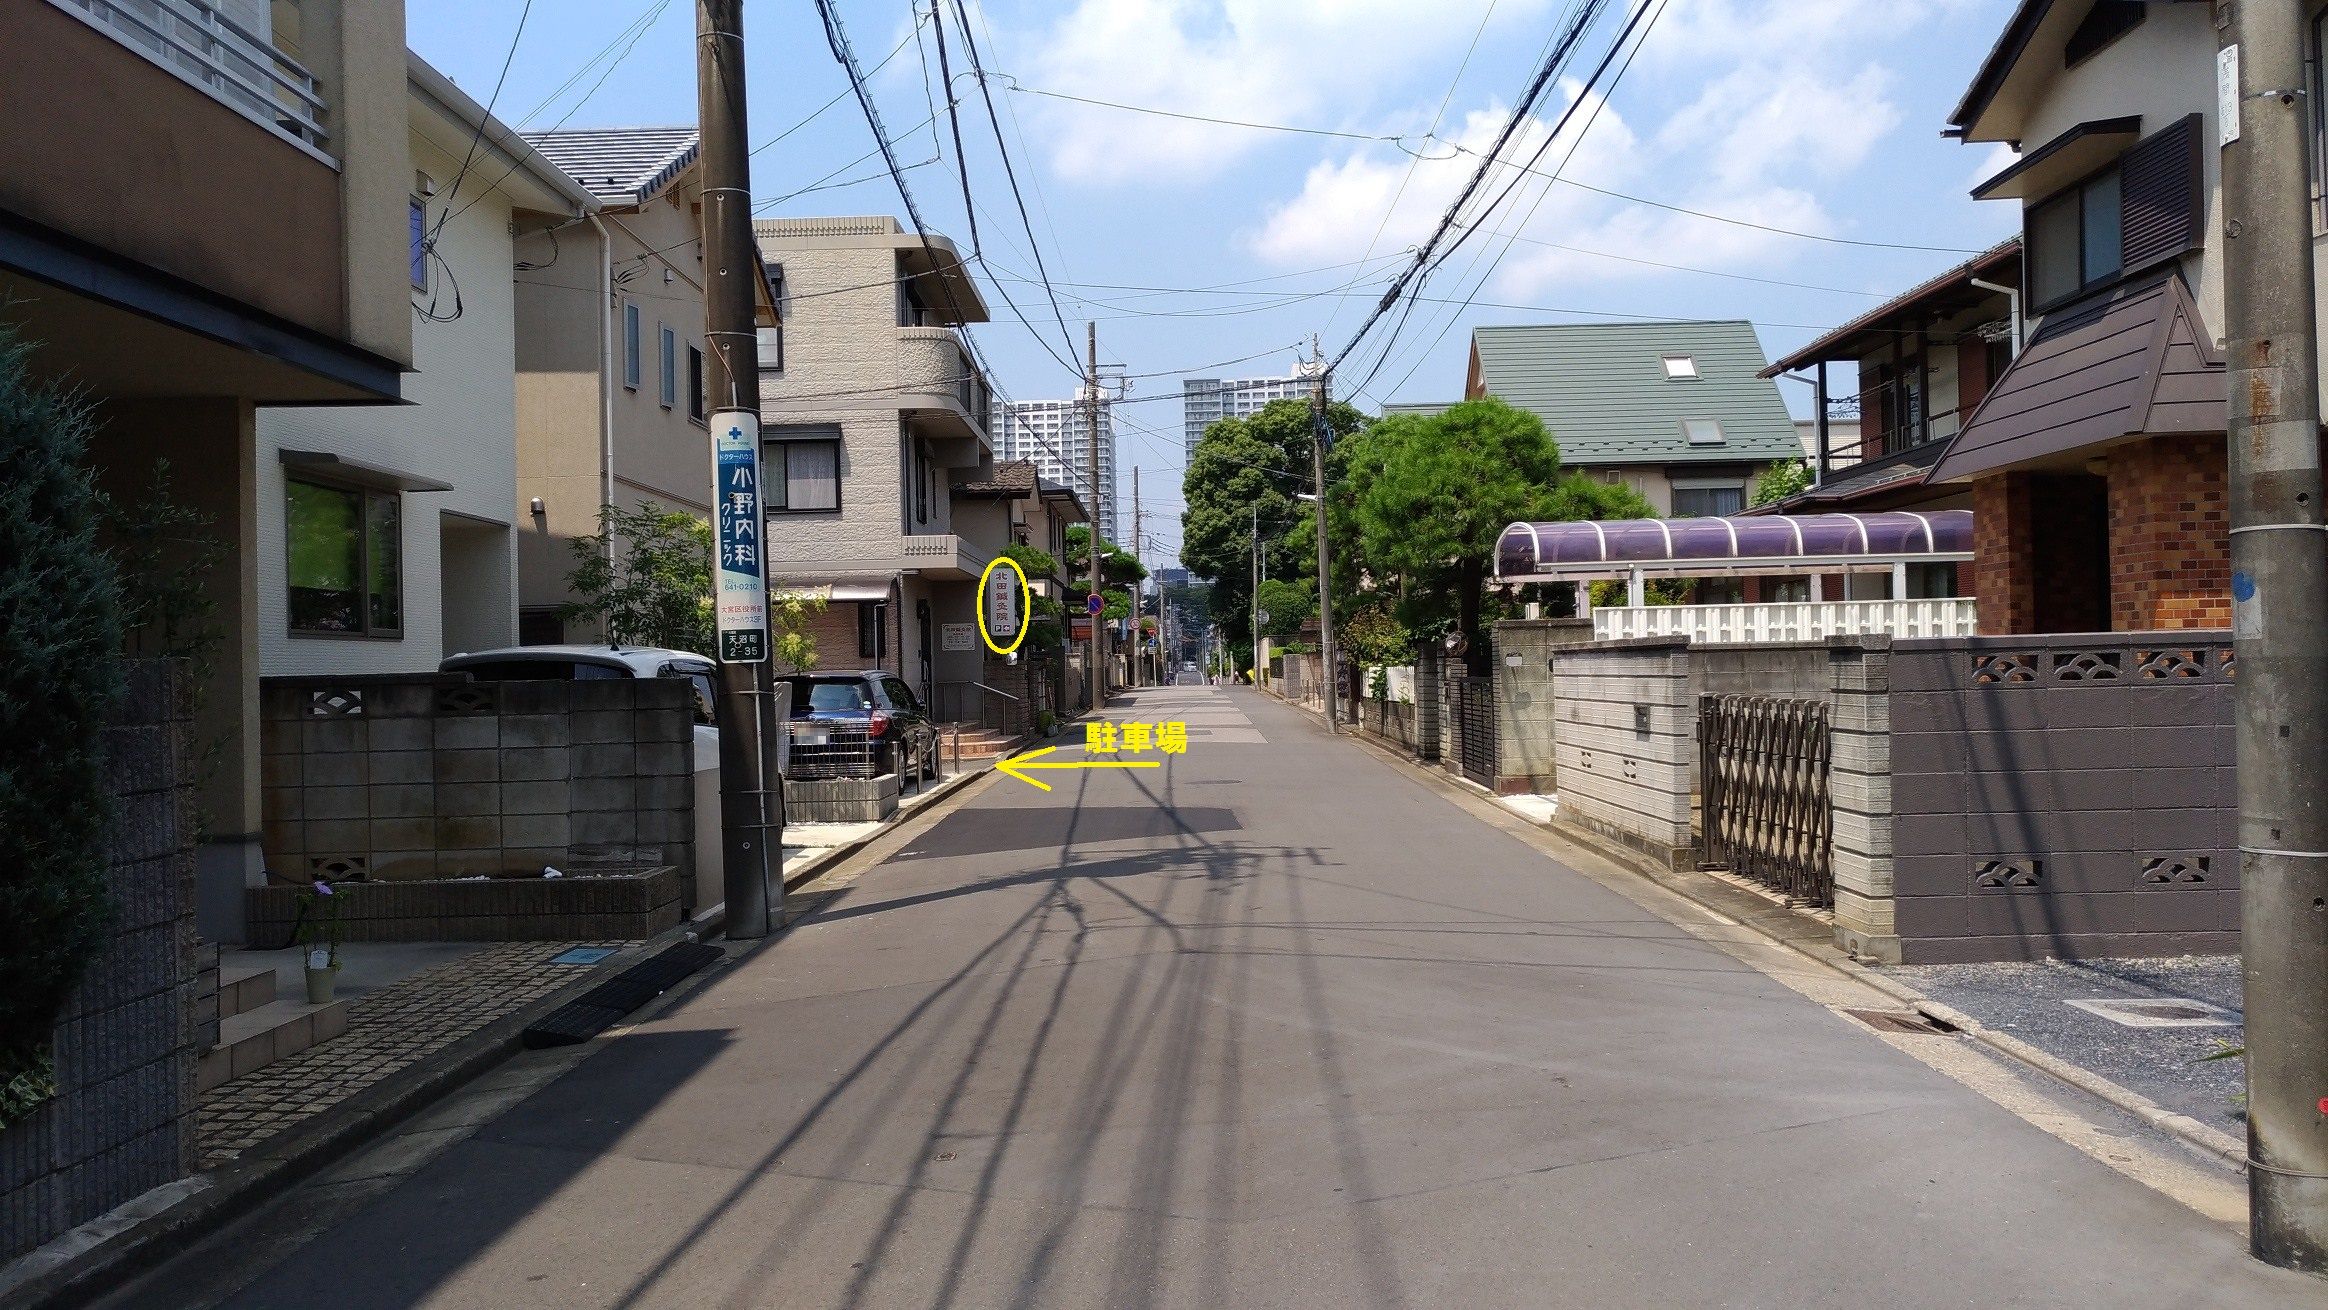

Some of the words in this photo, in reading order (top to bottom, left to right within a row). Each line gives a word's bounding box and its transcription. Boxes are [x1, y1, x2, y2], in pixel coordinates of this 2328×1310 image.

[719, 453, 754, 461] ドクターハウス
[731, 466, 756, 566] 小野内科
[721, 502, 733, 567] クリニック
[724, 583, 758, 591] 641-0210
[721, 605, 763, 614] 大宮区役所前
[728, 634, 758, 645] 天沼町
[730, 646, 758, 657] 2-35
